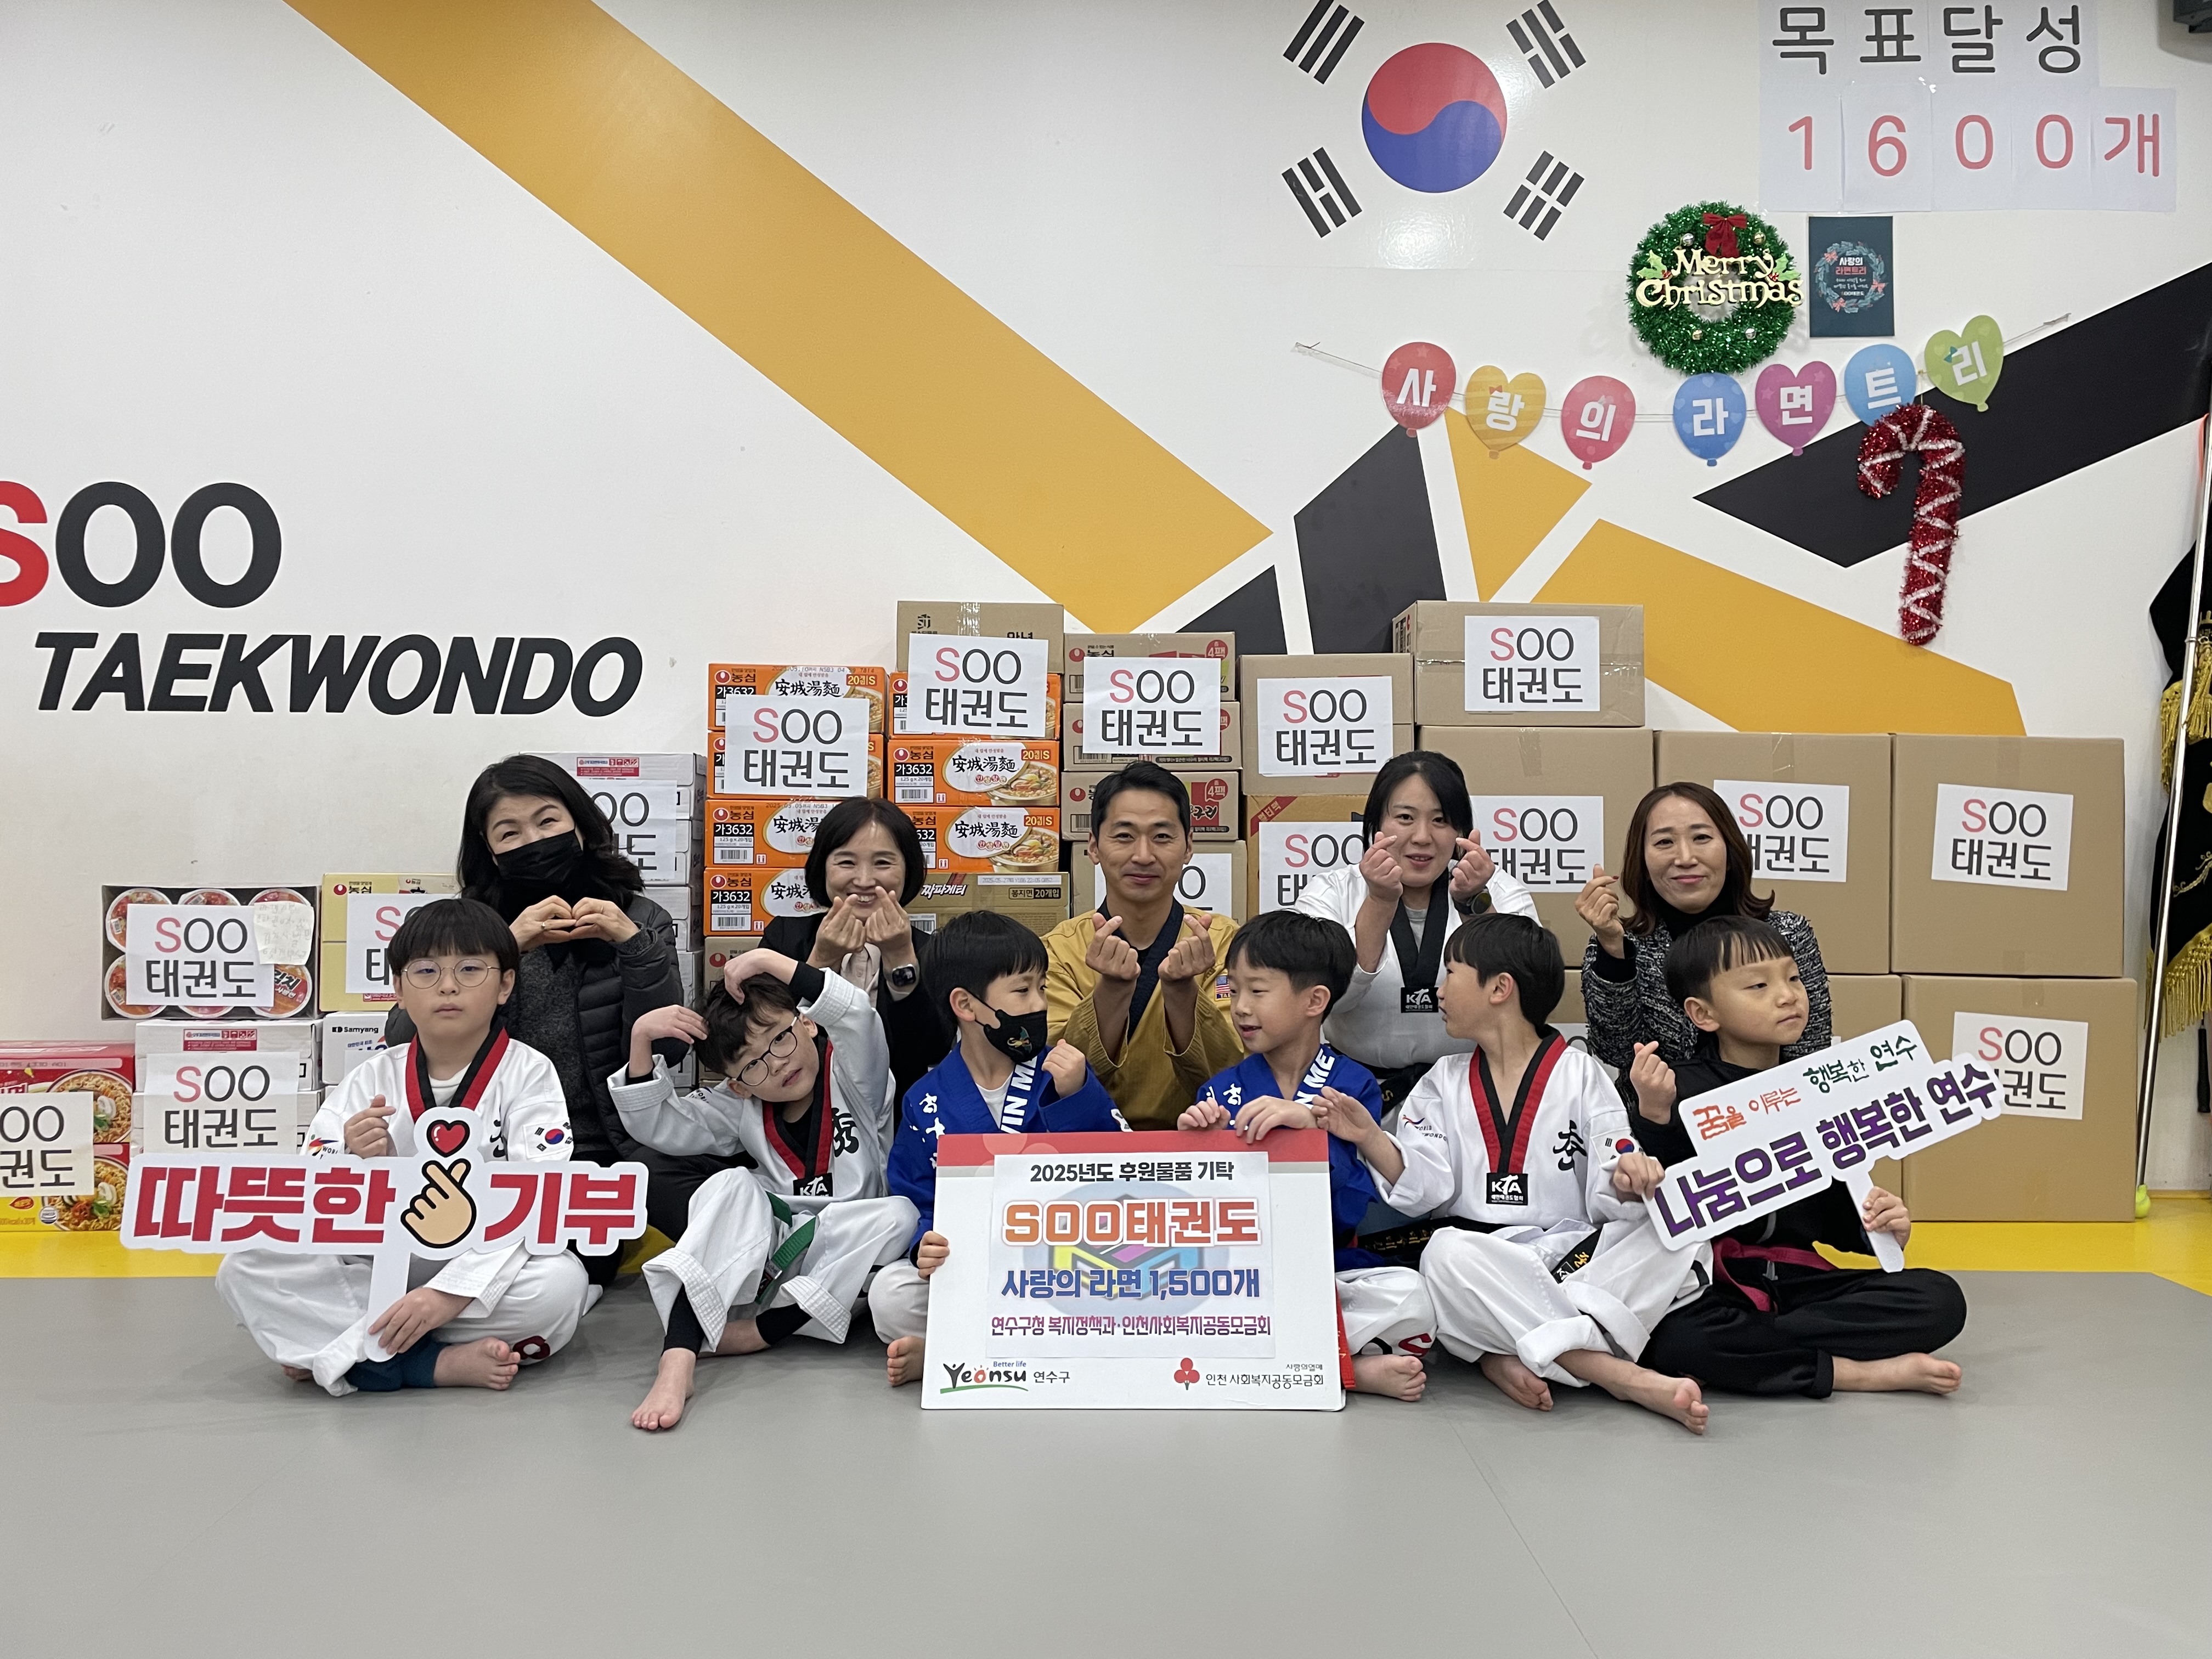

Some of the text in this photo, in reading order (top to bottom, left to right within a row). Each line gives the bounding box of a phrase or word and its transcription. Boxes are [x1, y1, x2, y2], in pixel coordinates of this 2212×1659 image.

[1671, 247, 1774, 279] Merry
[1835, 266, 1867, 275] 라면트리
[1839, 257, 1863, 266] 사랑의
[1635, 279, 1805, 311] Christmas
[1490, 627, 1574, 661] SOO
[35, 631, 642, 717] TAEKWONDO
[731, 673, 757, 683] 농심
[935, 647, 1022, 685] SOO
[716, 687, 755, 696] 가3632
[1110, 669, 1195, 703] SOO
[1482, 667, 1583, 704] 태권도
[926, 688, 1028, 728] 태권도
[1283, 689, 1367, 724] SOO
[753, 707, 842, 744] SOO
[1102, 709, 1203, 746] 태권도
[910, 749, 934, 760] 농심
[952, 755, 1017, 773] 安城湯麵
[1276, 729, 1376, 766] 태권도
[744, 749, 849, 788] 태권도
[896, 764, 933, 775] 가3632
[592, 792, 650, 827] OO
[730, 810, 754, 820] 농심
[773, 815, 822, 833] 安城湯
[913, 815, 936, 826] 농심
[1190, 805, 1218, 820] 구리
[1493, 808, 1578, 843] SOO
[1739, 793, 1824, 830] SOO
[1961, 799, 2047, 838] SOO
[715, 824, 753, 836] 가3632
[917, 830, 935, 840] 632
[955, 820, 1019, 838] 安城湯麵
[1285, 834, 1364, 868] SOO
[1951, 838, 2052, 882] 태권도
[713, 891, 751, 902] 가3632
[727, 877, 752, 887] 농심
[921, 883, 968, 900] 짜파게티
[1011, 888, 1059, 898] 봉지면 20개입
[154, 917, 248, 953] SOO
[145, 960, 256, 998] 태권도
[1406, 988, 1432, 1005] KTA
[1977, 1026, 2062, 1067] SOO
[173, 1065, 270, 1103] SOO
[1303, 1048, 1335, 1088] ME
[1692, 1035, 1917, 1141] 꿈을 이루는 행복한 연수
[1997, 1070, 2067, 1111] 권도
[0, 1105, 64, 1143] OO
[164, 1108, 278, 1149] 태권도
[1655, 1063, 1997, 1238] 나눔으로 행복한 연수
[0, 1149, 75, 1188] 권도
[1030, 1161, 1234, 1183] 2025년도 후원물품 기탁
[1491, 1175, 1522, 1195] KTA
[800, 1176, 828, 1196] KTA
[133, 1166, 636, 1245] 따뜻한 기부
[1003, 1198, 1262, 1248] SOO태권도
[1001, 1269, 1260, 1301] 사랑의 라면 1,500개
[991, 1316, 1045, 1336] 연수구청
[943, 1362, 1027, 1389] Yeonsu
[1033, 1370, 1070, 1384] 연수구
[1206, 1373, 1324, 1389] 인천 사회복지공동모금회
